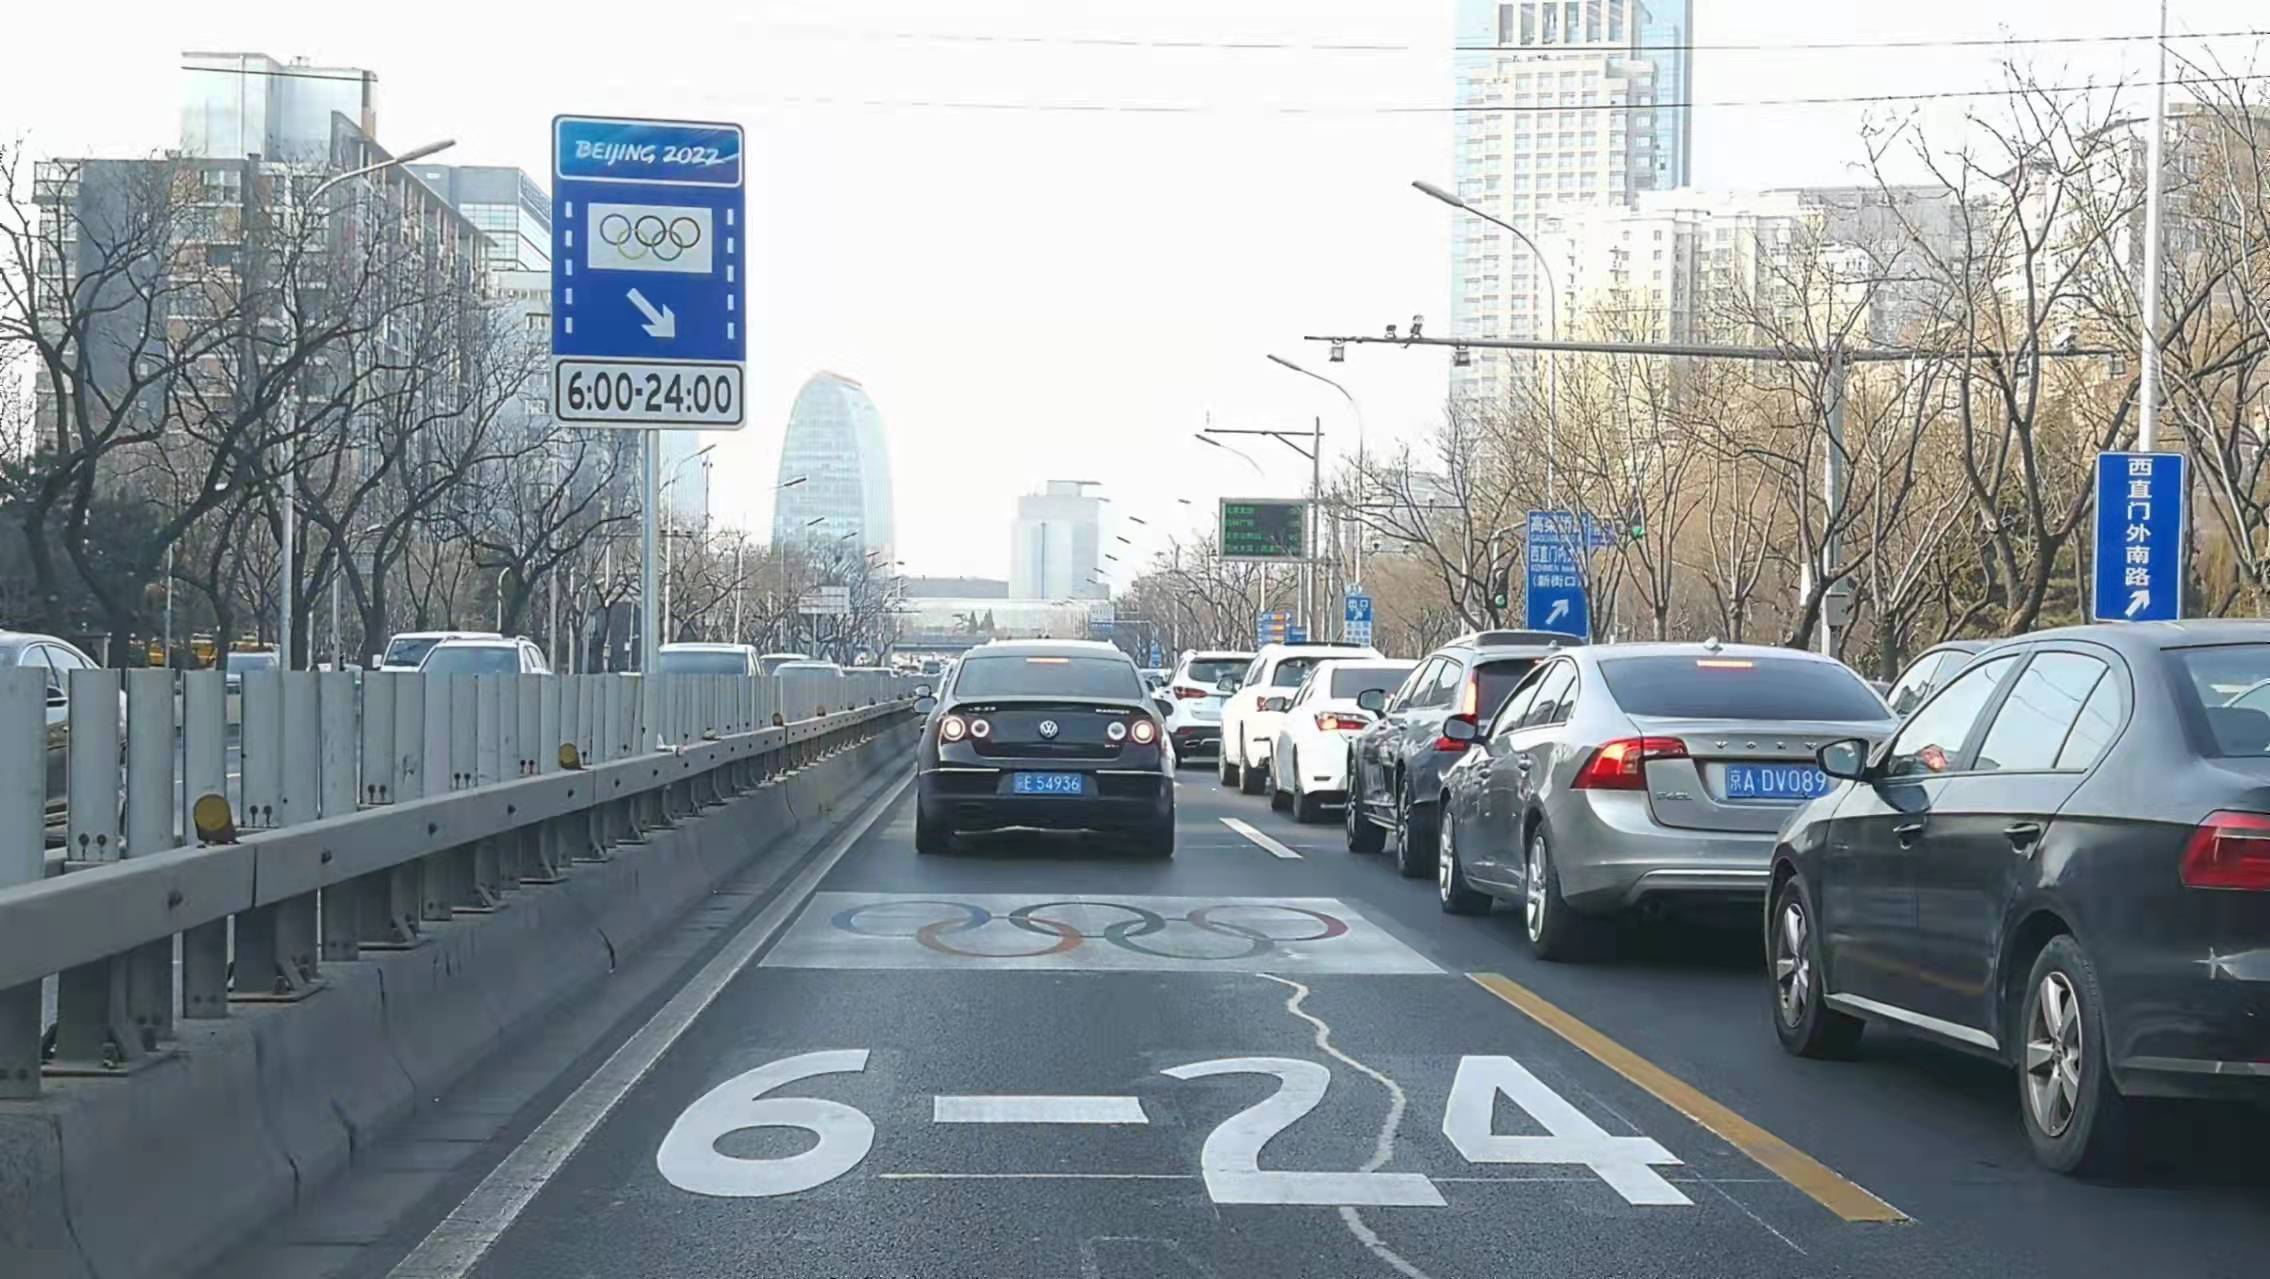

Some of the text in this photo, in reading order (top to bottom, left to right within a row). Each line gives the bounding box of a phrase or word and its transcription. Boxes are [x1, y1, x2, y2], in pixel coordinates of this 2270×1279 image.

[575, 140, 727, 167] BEIJING 2022
[567, 371, 732, 414] 6:00-24:00
[2124, 458, 2153, 586] 西直门外南路
